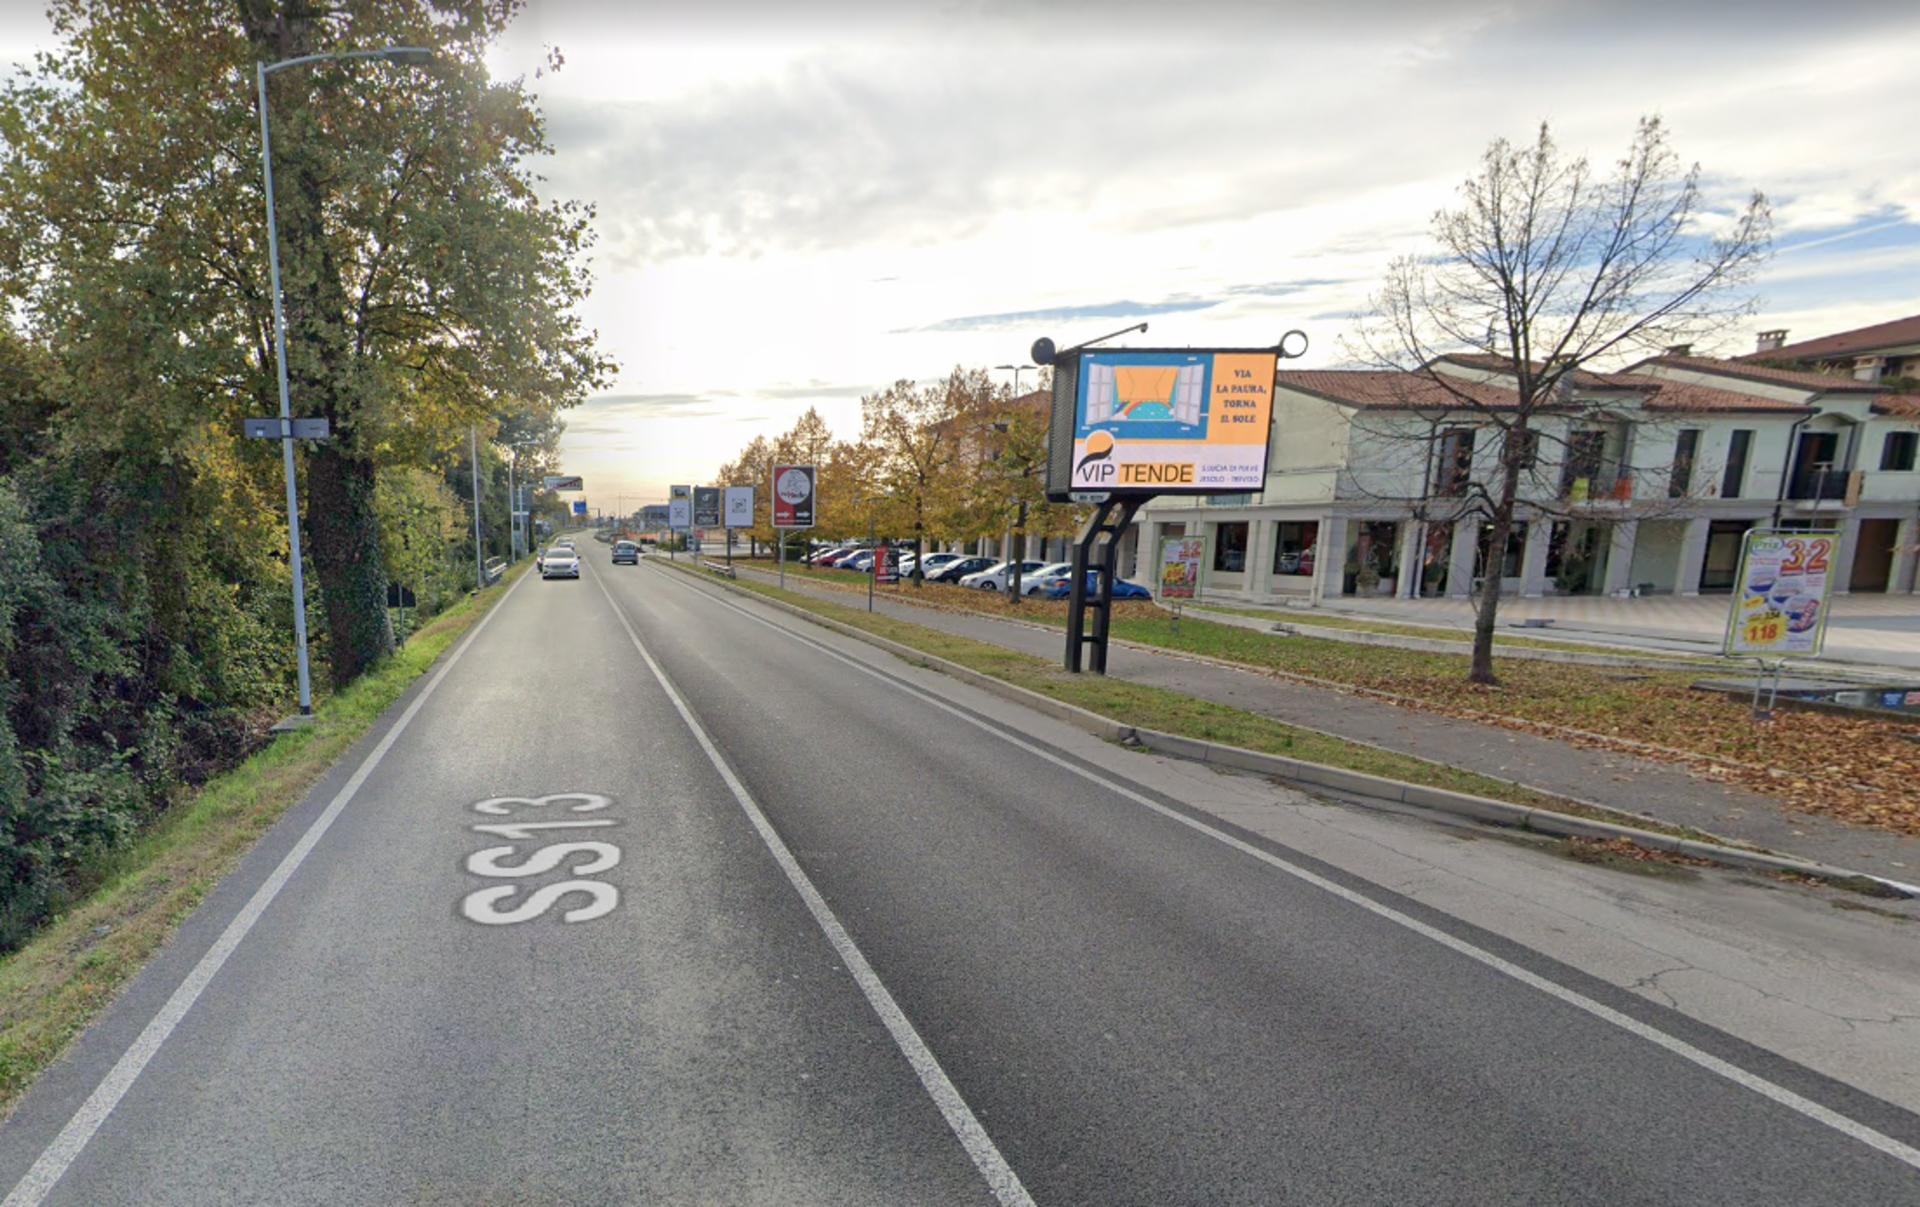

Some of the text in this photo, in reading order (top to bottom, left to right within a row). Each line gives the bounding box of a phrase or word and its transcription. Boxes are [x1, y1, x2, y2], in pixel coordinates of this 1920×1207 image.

[1234, 369, 1252, 378] VIA
[1216, 385, 1228, 393] LA
[1223, 400, 1257, 408] TORNA
[1232, 415, 1256, 423] SOLE
[1082, 463, 1194, 482] VIP TENDE
[464, 792, 621, 925] SS13
